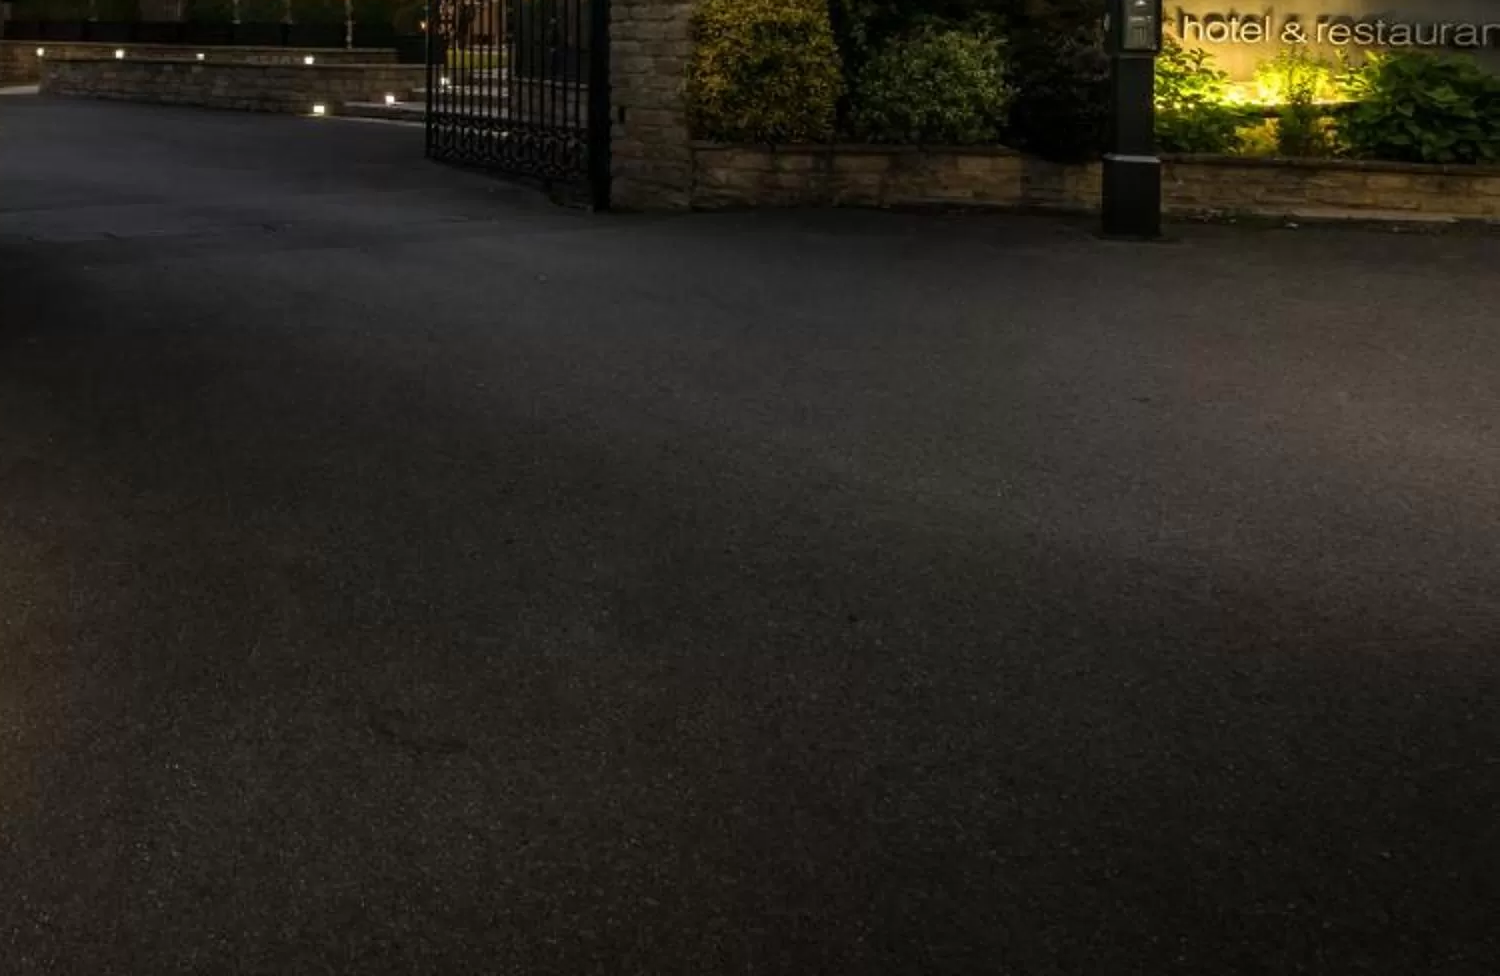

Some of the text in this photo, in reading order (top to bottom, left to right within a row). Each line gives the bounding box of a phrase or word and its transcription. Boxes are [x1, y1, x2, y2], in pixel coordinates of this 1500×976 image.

[1183, 15, 1500, 46] hotel & restauran
